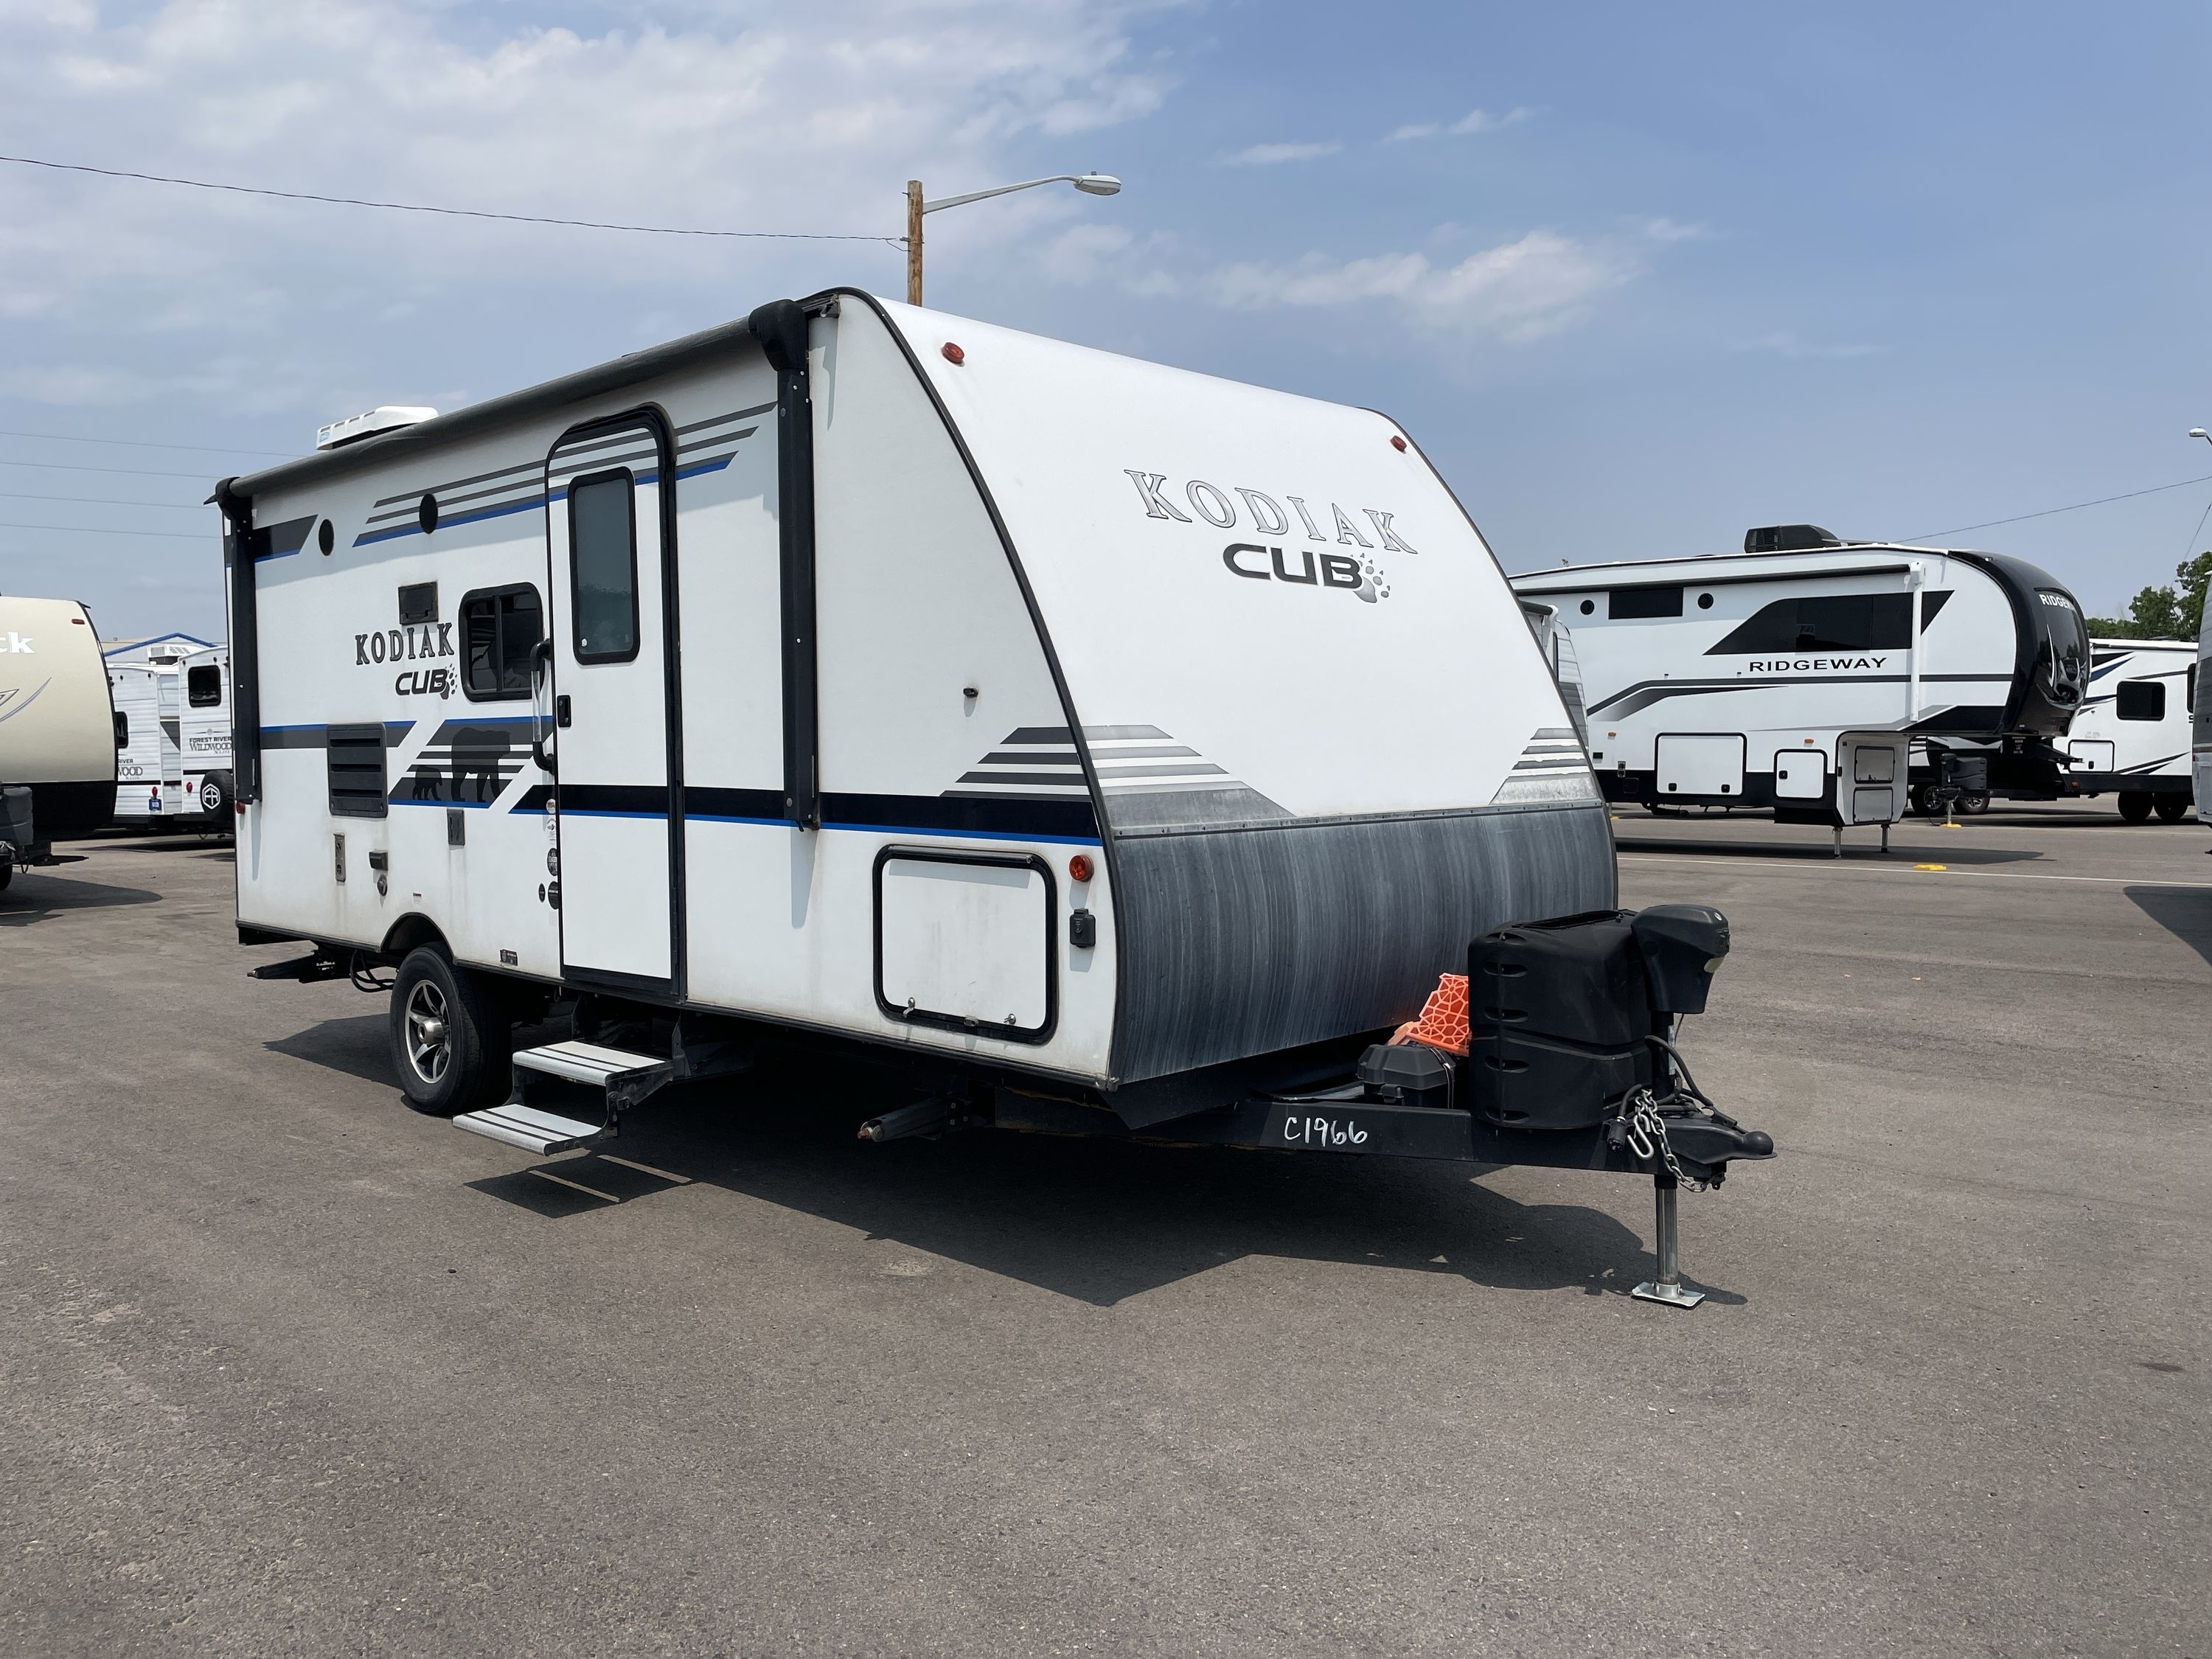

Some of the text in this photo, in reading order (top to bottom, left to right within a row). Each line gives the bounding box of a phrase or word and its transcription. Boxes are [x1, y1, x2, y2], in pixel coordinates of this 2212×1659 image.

[1124, 469, 1418, 554] KODIAK
[1222, 543, 1363, 589] CUB
[355, 622, 455, 666] KODIAK
[394, 668, 448, 696] CUB
[1749, 657, 1887, 672] RIDGEWAY
[1284, 1116, 1368, 1147] C1966
